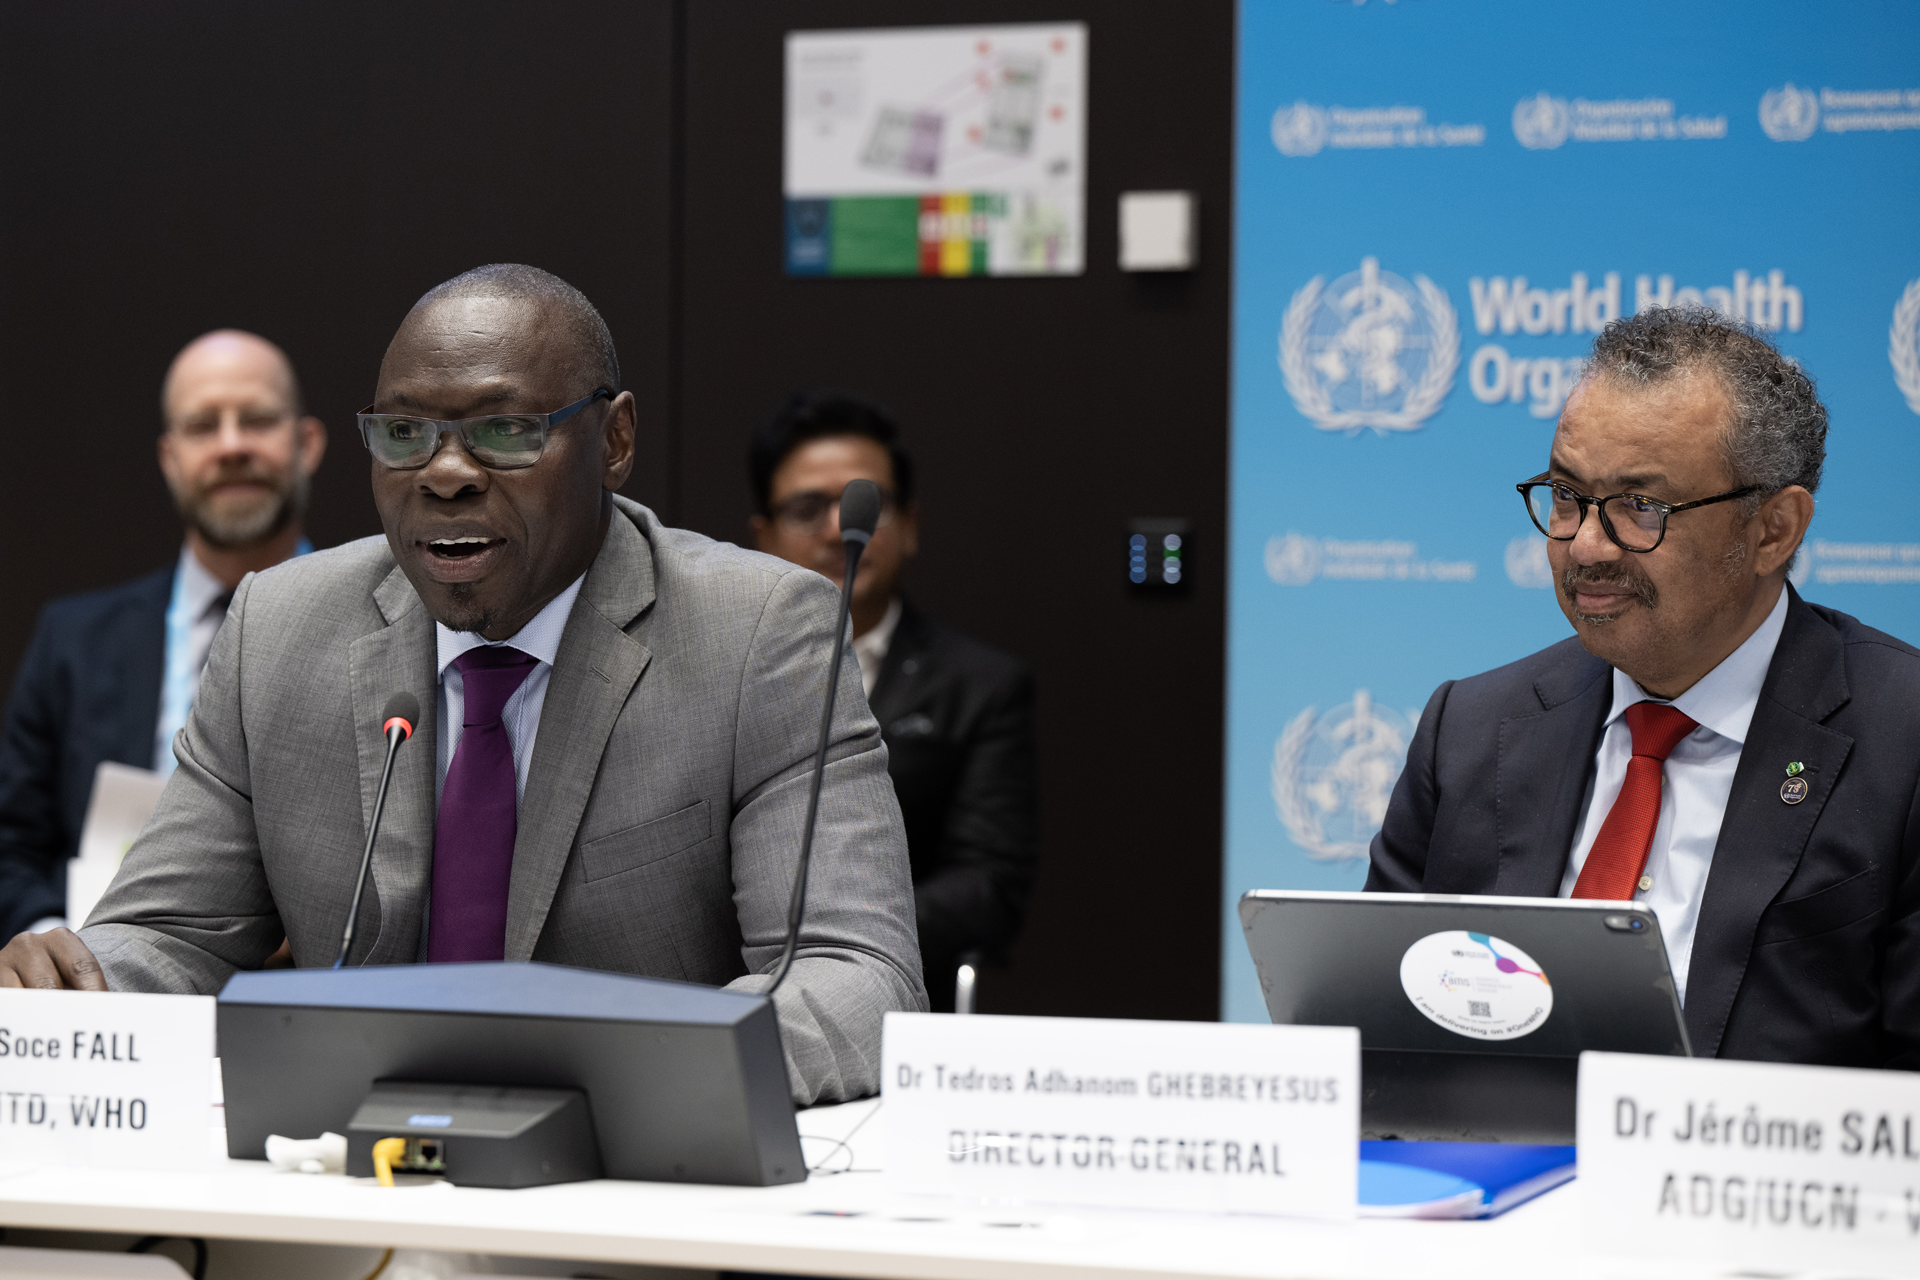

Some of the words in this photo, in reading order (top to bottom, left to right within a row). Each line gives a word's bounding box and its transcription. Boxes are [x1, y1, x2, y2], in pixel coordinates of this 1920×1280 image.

[1469, 271, 1621, 335] World
[0, 1027, 61, 1060] Soce
[72, 1030, 141, 1063] FALL
[1436, 1013, 1488, 1036] delivering
[896, 1063, 923, 1090] Dr
[934, 1064, 1015, 1093] Tedros
[1023, 1067, 1139, 1097] Adhanom
[1146, 1070, 1340, 1104] GHEBREYESUS
[0, 1091, 57, 1130] TD,
[69, 1094, 148, 1131] WHO
[1614, 1095, 1657, 1140] Dr
[1672, 1100, 1825, 1154] Jérôme
[1656, 1170, 1861, 1232] ADG/UCN
